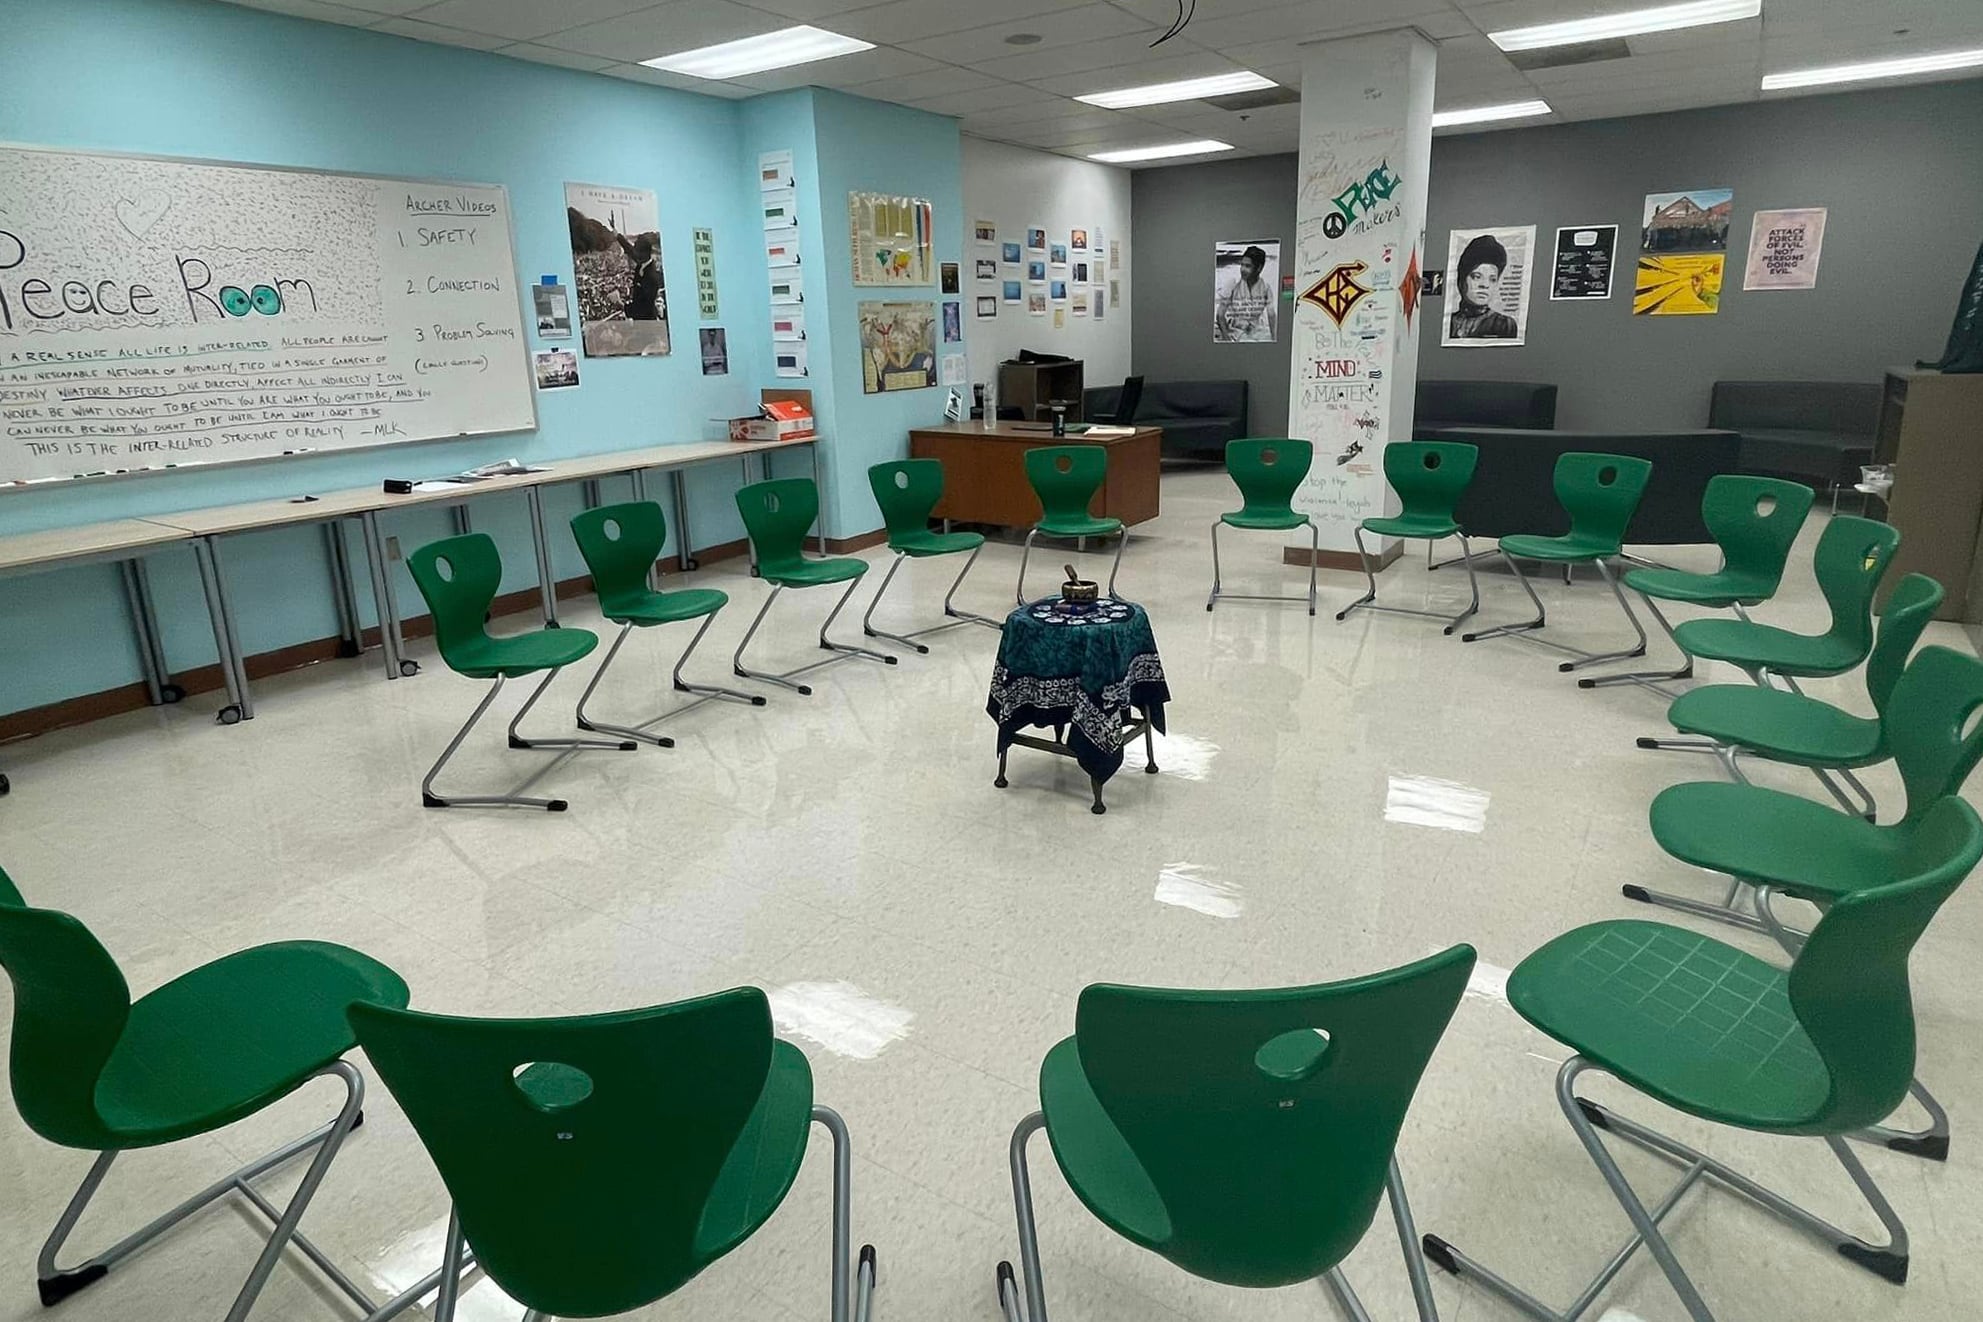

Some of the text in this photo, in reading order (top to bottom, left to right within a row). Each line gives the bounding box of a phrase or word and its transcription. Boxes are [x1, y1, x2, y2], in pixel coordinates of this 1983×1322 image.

[406, 194, 496, 213] ARCHER VIDEOS
[418, 227, 476, 246] SAFETY
[1769, 228, 1805, 236] ATTACK
[1762, 254, 1804, 262] PERSONS
[427, 275, 500, 294] CONNECTION
[414, 328, 424, 342] 3
[433, 323, 473, 340] PROBLEM
[11, 352, 20, 361] A
[26, 351, 63, 361] REAL
[67, 349, 107, 359] SENSE
[119, 348, 142, 357] ALL
[146, 346, 171, 355] LIFE
[178, 345, 189, 355] IS
[281, 337, 300, 346] ALL
[342, 335, 360, 343] ARE
[11, 373, 27, 382] AN
[106, 367, 160, 378] NETWORK
[1315, 360, 1356, 379] MIND
[118, 385, 167, 396] AFFECTS
[177, 382, 200, 392] ONE
[298, 377, 317, 387] ALL
[387, 373, 403, 381] CAN
[3, 408, 43, 419] NEVER
[48, 406, 65, 417] BE
[71, 405, 102, 416] WHAT
[200, 397, 234, 407] UNTIL
[238, 396, 254, 406] YOU
[260, 394, 277, 404] ARE
[283, 394, 309, 404] WHAT
[313, 392, 331, 406] YOU
[396, 389, 413, 397] AND
[7, 426, 31, 436] CAN
[36, 425, 75, 435] NEVER
[80, 425, 97, 434] BE
[100, 424, 127, 434] WHAT
[154, 422, 186, 431] OUGHT
[194, 417, 206, 427] TO
[210, 416, 223, 426] BE
[292, 411, 315, 419] WHAT
[24, 442, 59, 457] THIS
[66, 442, 82, 455] IS
[85, 443, 119, 455] THE
[129, 437, 213, 453] INTER-RELATED
[286, 427, 299, 437] OF
